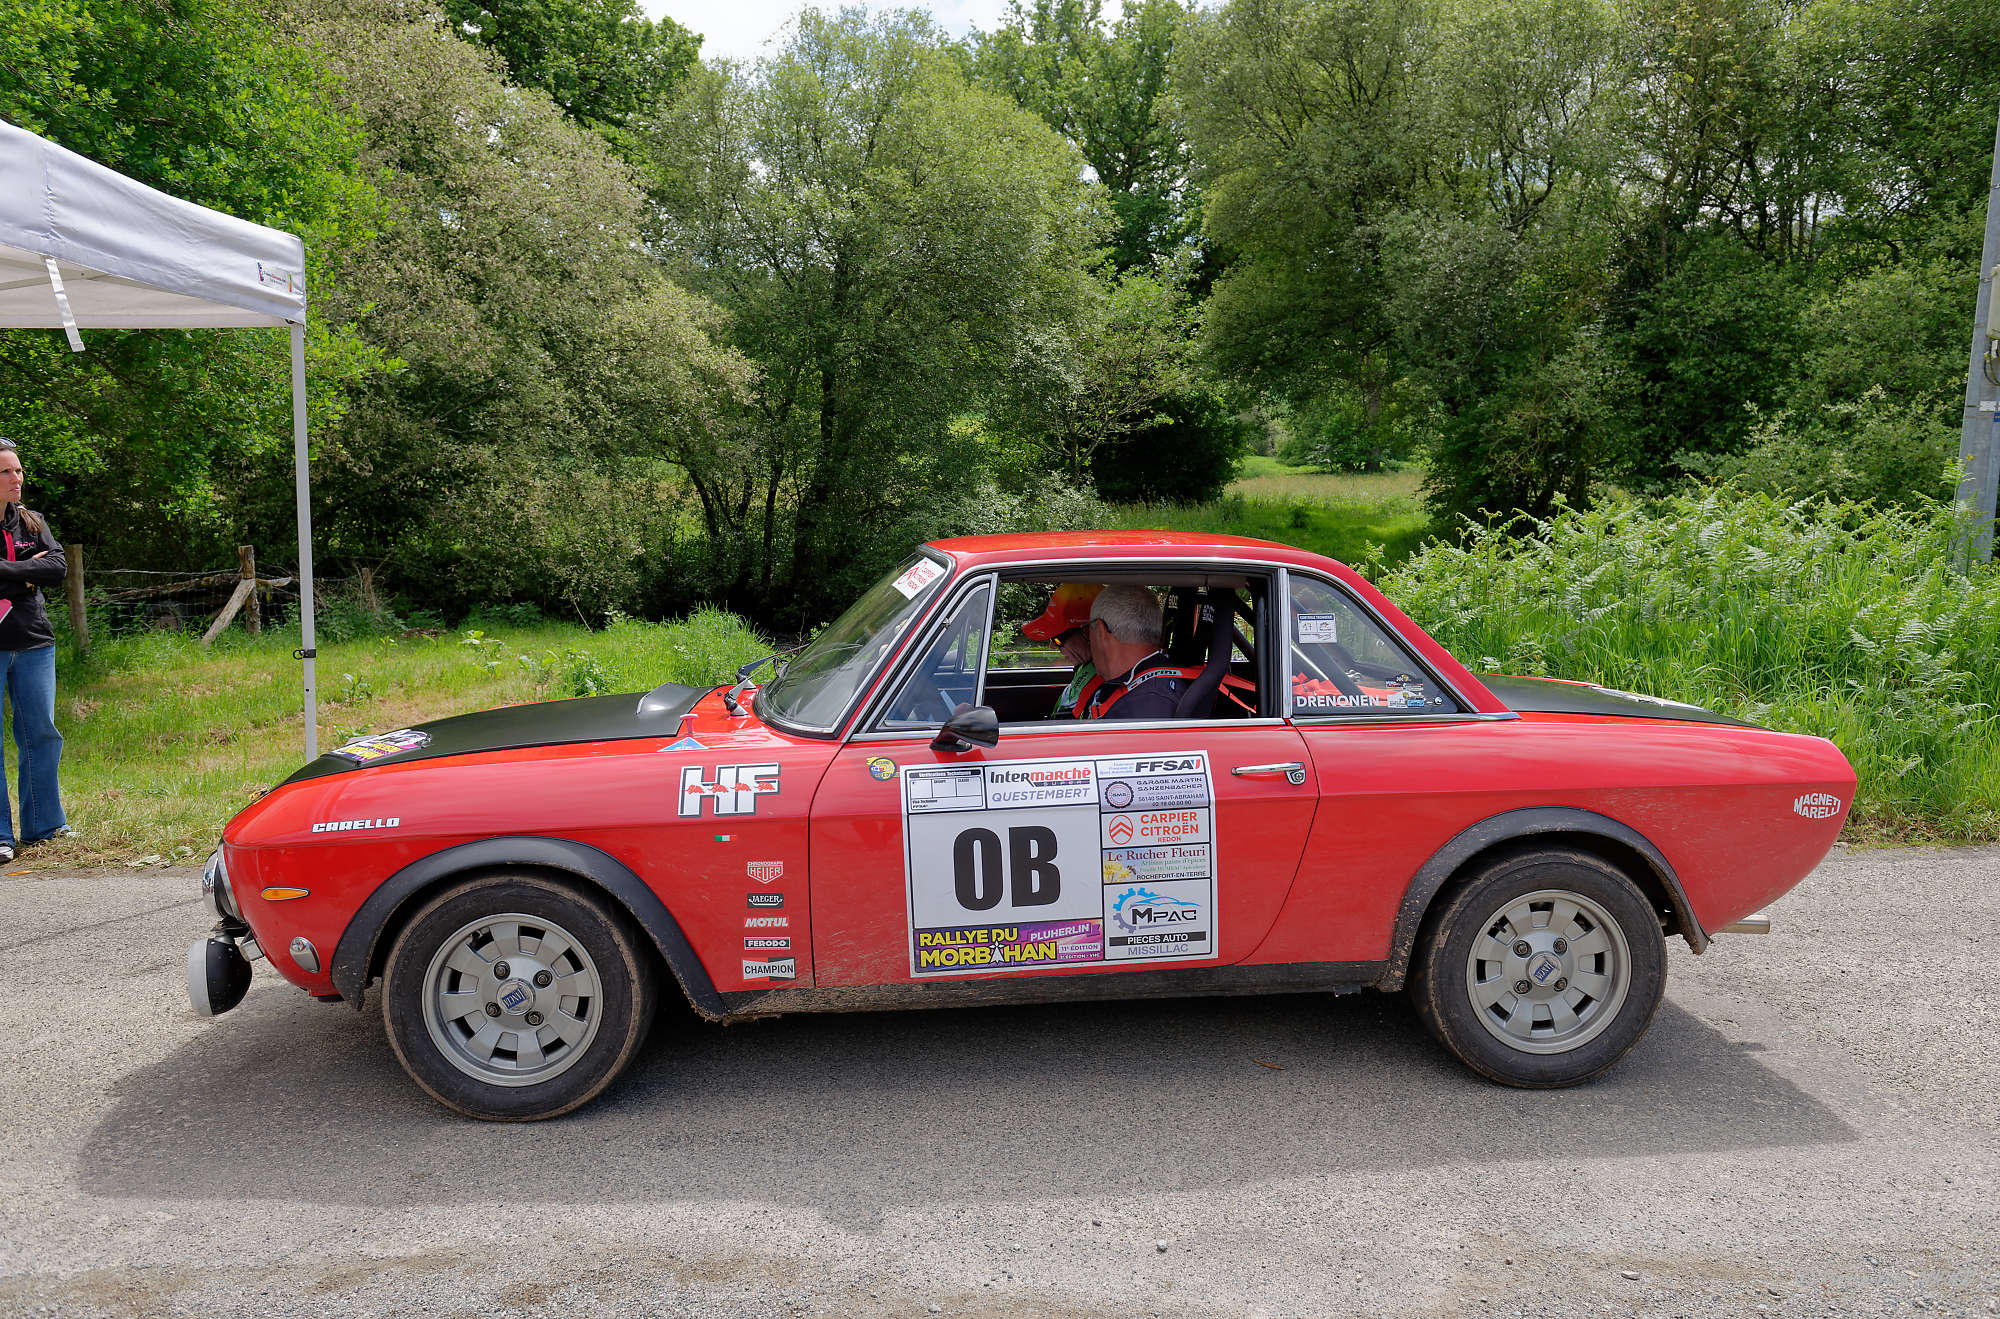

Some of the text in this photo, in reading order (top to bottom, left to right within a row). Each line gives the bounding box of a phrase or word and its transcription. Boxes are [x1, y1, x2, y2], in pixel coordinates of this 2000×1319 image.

[1296, 695, 1380, 708] DRENONEN
[1135, 759, 1194, 773] FFSA
[678, 762, 781, 817] HF
[991, 788, 1090, 802] QUESTEMBERT
[1140, 811, 1197, 824] CARPIER
[312, 817, 400, 833] CARELLO
[1140, 822, 1199, 836] CITROËN
[1107, 846, 1206, 862] Le Rucher Fleuri
[750, 867, 780, 880] HEUER
[1136, 871, 1207, 880] ROCHEFORT-EN-TERRE
[745, 917, 788, 927] MOTUL
[1131, 907, 1197, 925] MPAC
[919, 928, 1018, 947] RALLYE DU
[1030, 924, 1091, 941] PLUHERLIN
[1127, 933, 1189, 945] PIECES AUTO
[1128, 944, 1189, 955] MISSILLAC
[744, 965, 794, 975] CHAMPION
